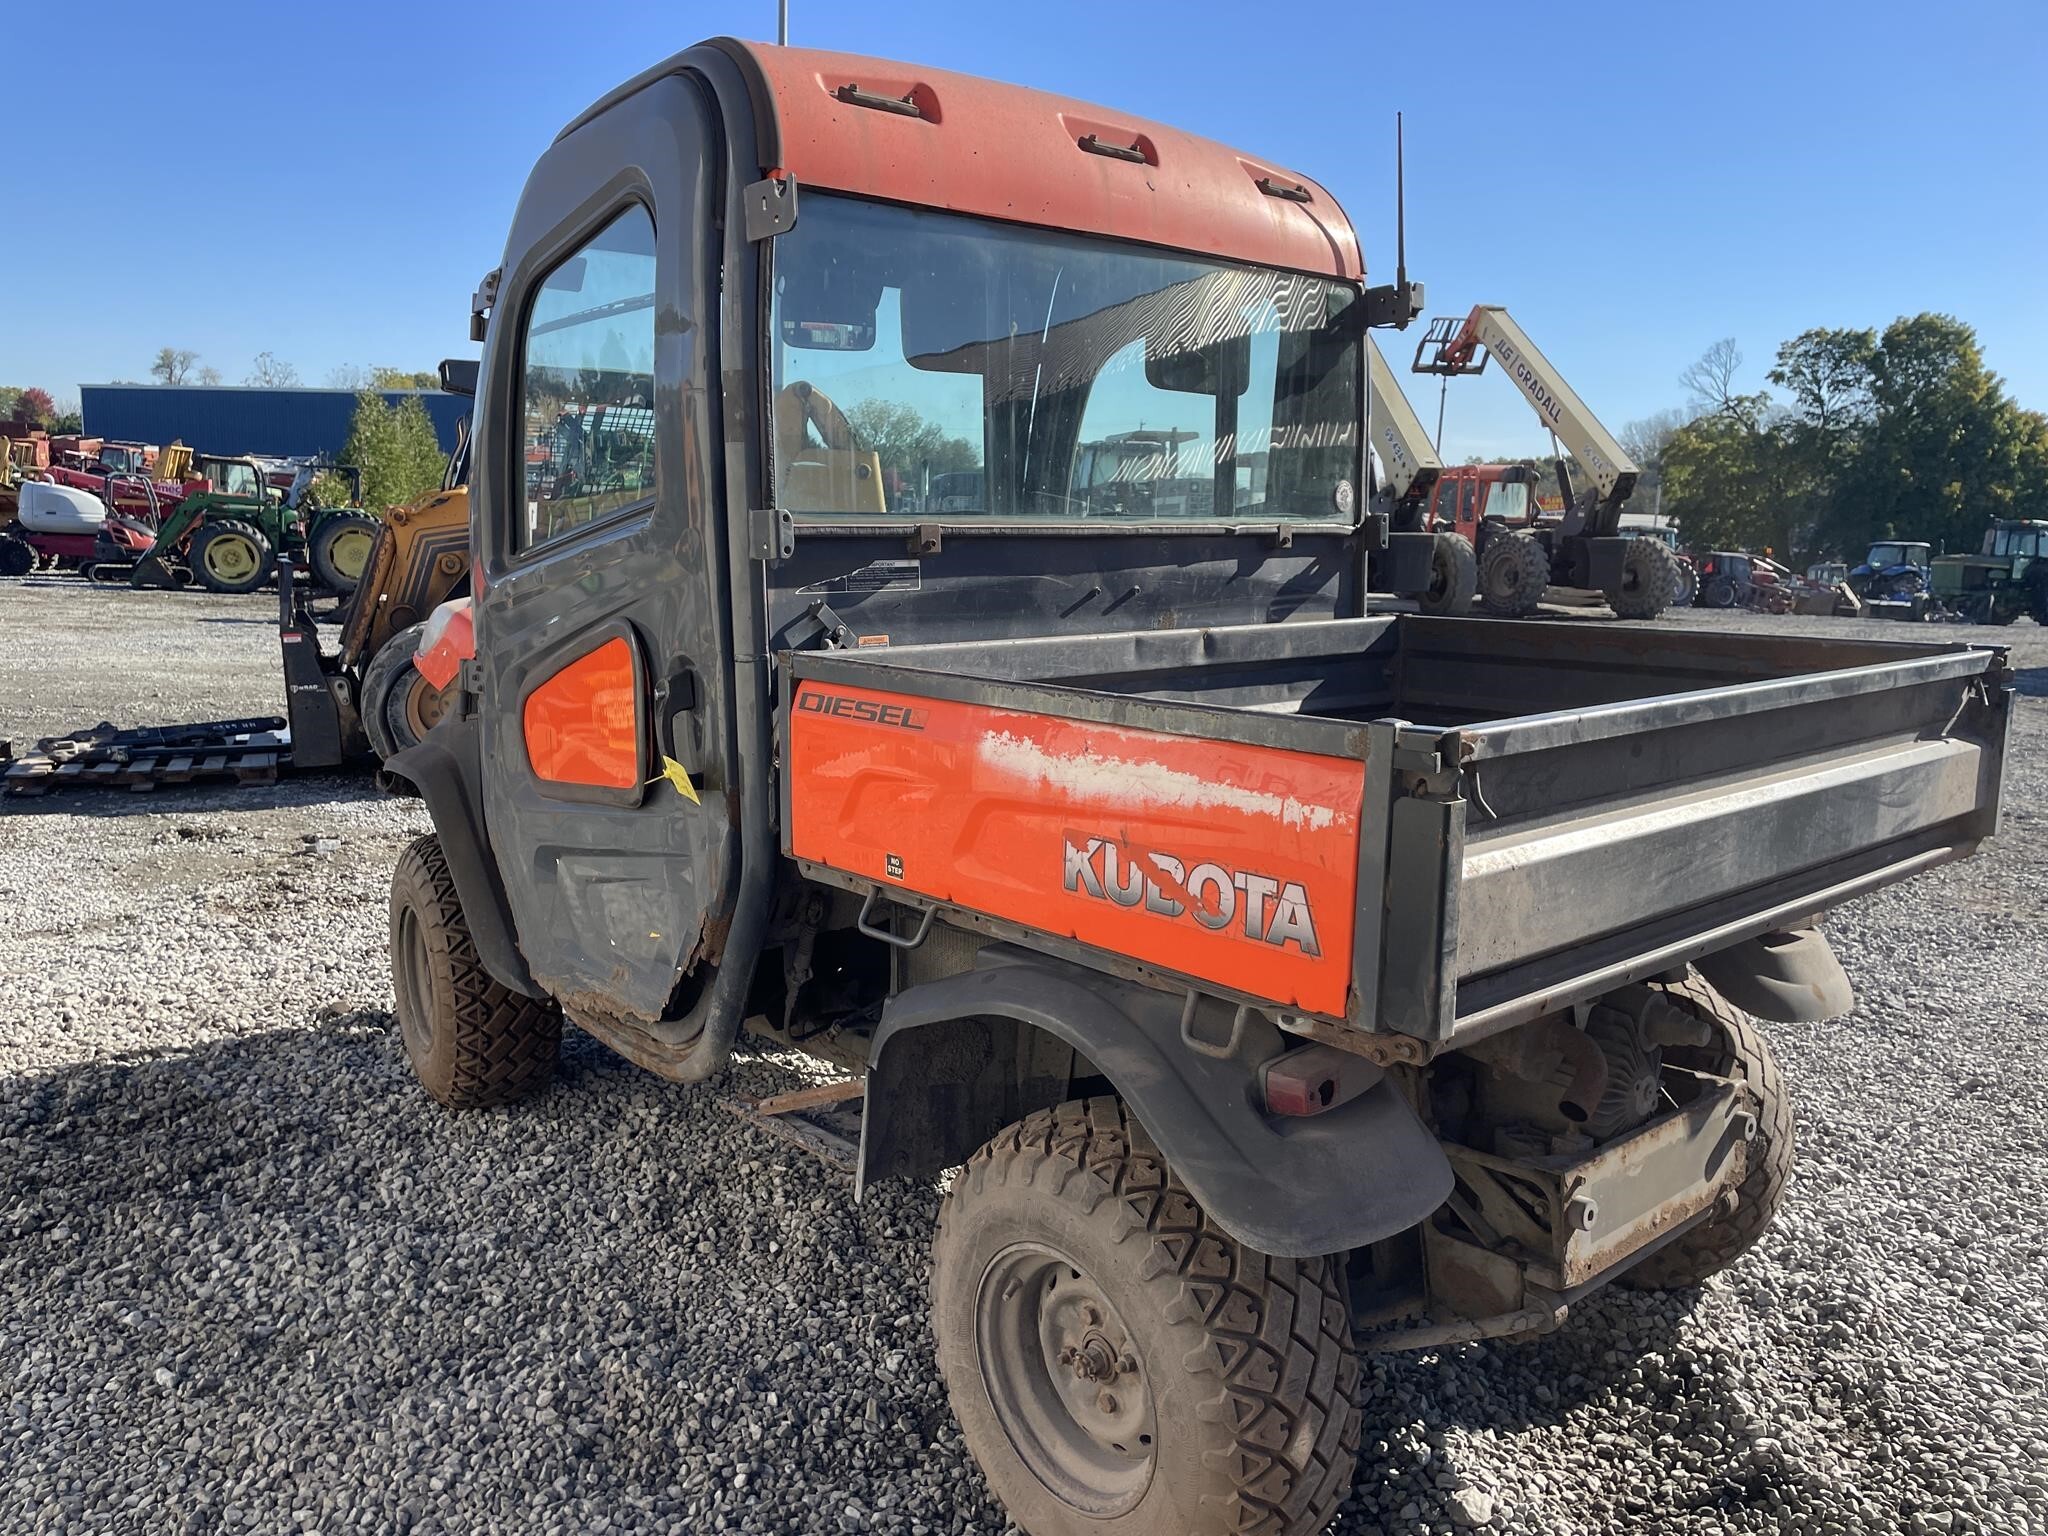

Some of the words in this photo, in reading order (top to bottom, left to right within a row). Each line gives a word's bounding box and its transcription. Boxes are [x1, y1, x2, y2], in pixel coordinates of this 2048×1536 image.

[1495, 339, 1513, 361] JLG
[1517, 362, 1561, 424] GRADALL
[799, 692, 925, 730] DIESEL
[887, 864, 903, 875] STEP
[890, 857, 900, 866] NO
[1063, 837, 1322, 957] KUBOTA
